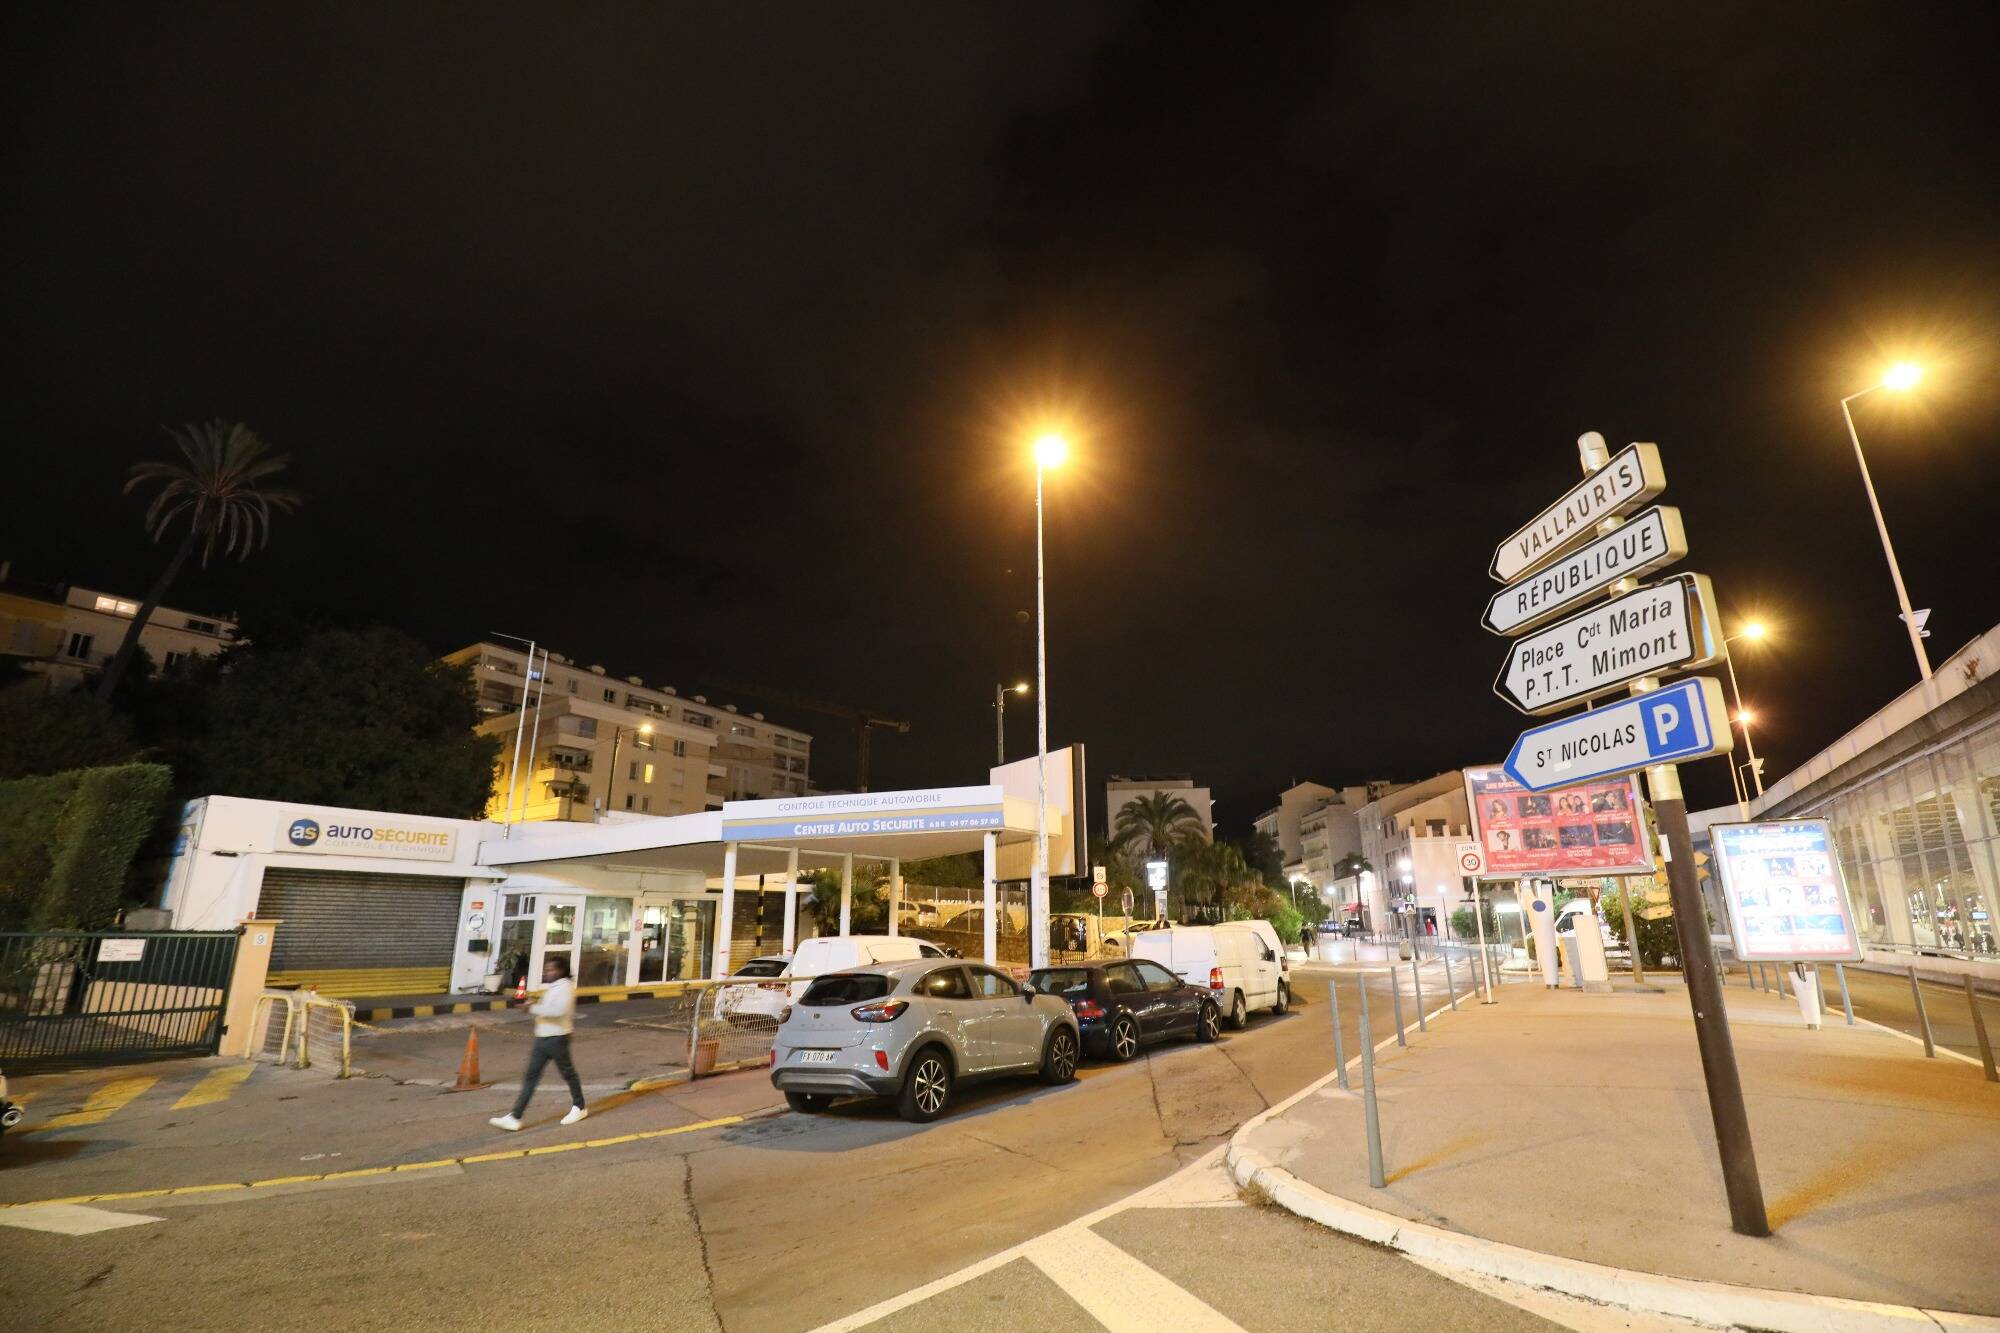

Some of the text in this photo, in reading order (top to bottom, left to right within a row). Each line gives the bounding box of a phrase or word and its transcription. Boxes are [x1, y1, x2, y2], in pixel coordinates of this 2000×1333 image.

[1519, 464, 1633, 559] VALLAURIS
[1517, 526, 1653, 614] RÉPUBLIQUE
[1521, 599, 1673, 672] Place Cdt Maria
[1525, 629, 1678, 699] P.T.T. Mimont
[1561, 724, 1636, 762] NICOLAS
[1652, 703, 1680, 745] P
[290, 825, 319, 840] as
[794, 823, 835, 836] CENTRE
[837, 821, 870, 833] AUTO
[827, 797, 879, 809] TECHNIQUE
[881, 793, 942, 805] AUTOMOBILE
